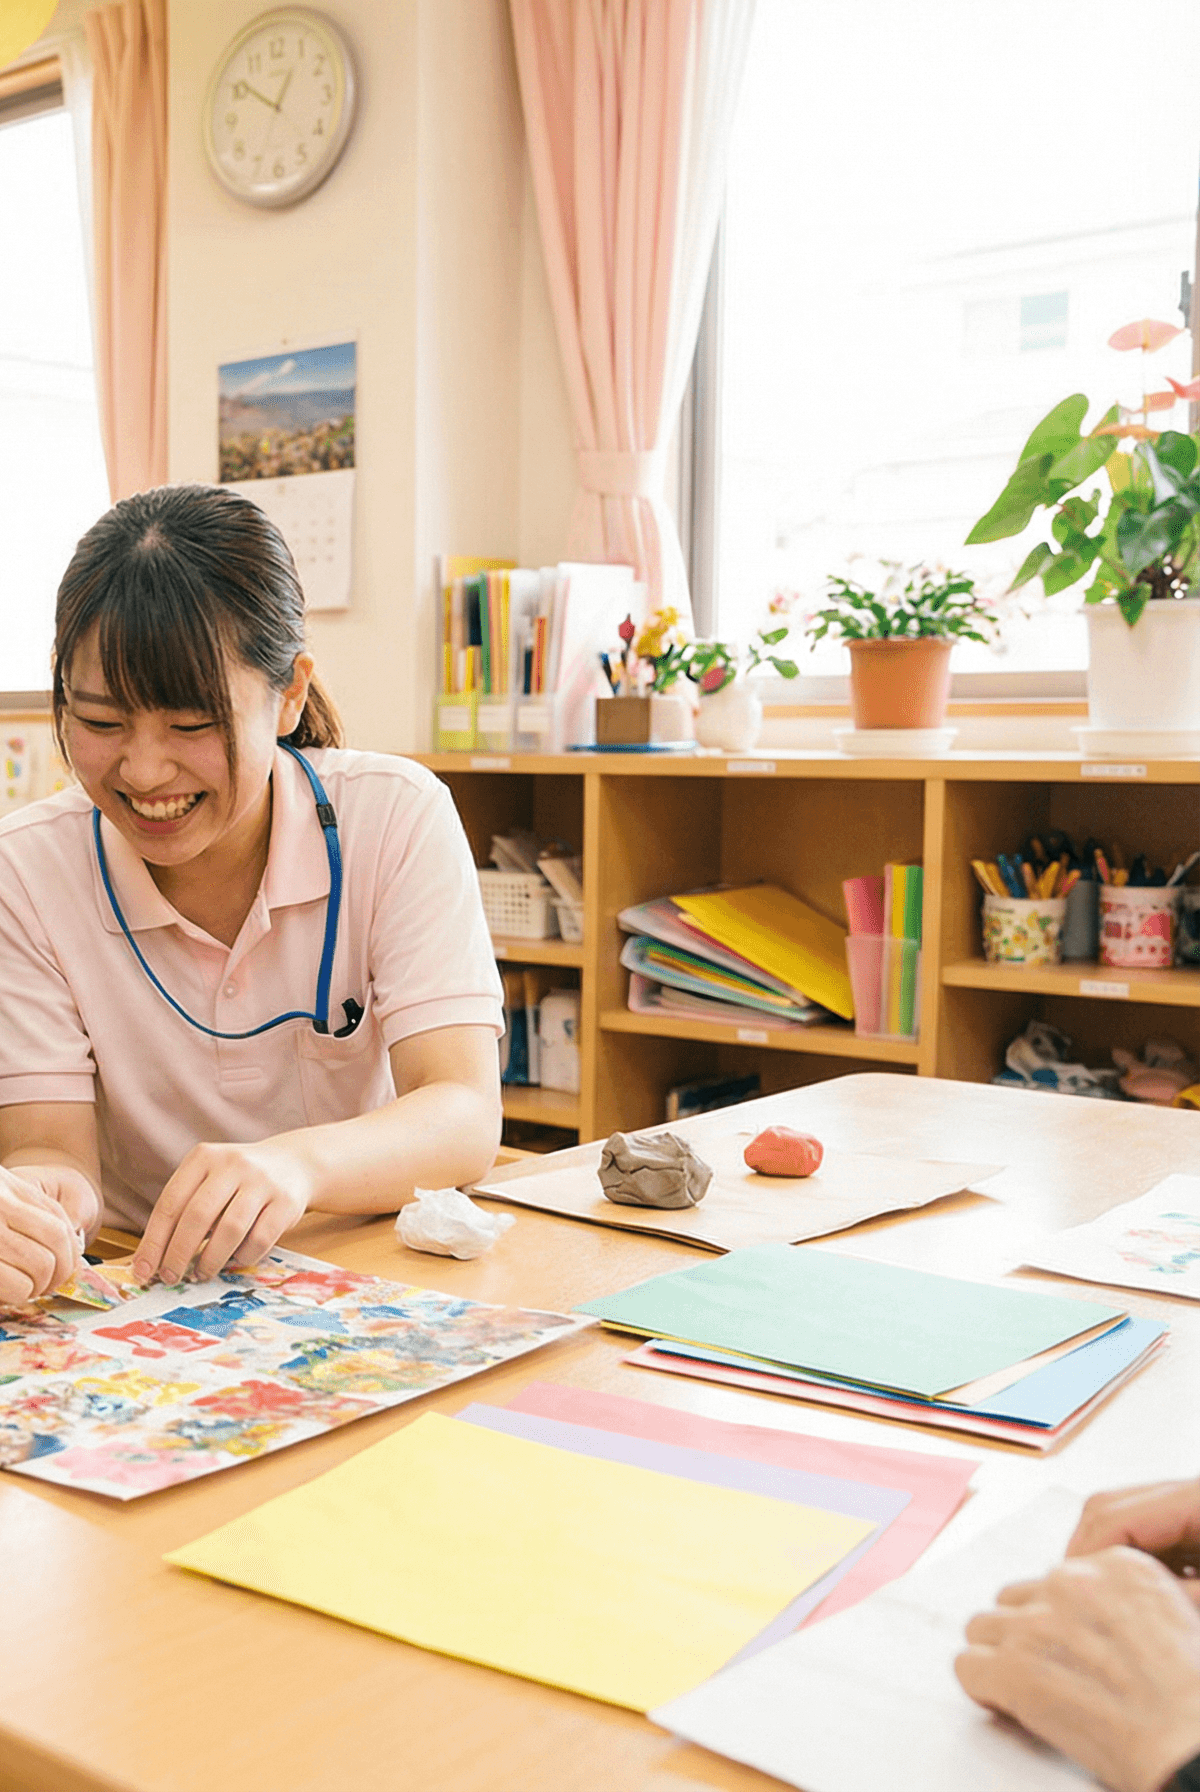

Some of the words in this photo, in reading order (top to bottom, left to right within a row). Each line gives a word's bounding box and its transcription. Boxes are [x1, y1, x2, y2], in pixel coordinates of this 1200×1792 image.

[269, 37, 284, 59] 12
[247, 53, 261, 73] 11
[313, 53, 326, 76] 2
[321, 84, 333, 105] 3
[313, 118, 324, 136] 4
[296, 142, 308, 165] 5
[253, 154, 264, 177] 7
[273, 157, 285, 178] 6
